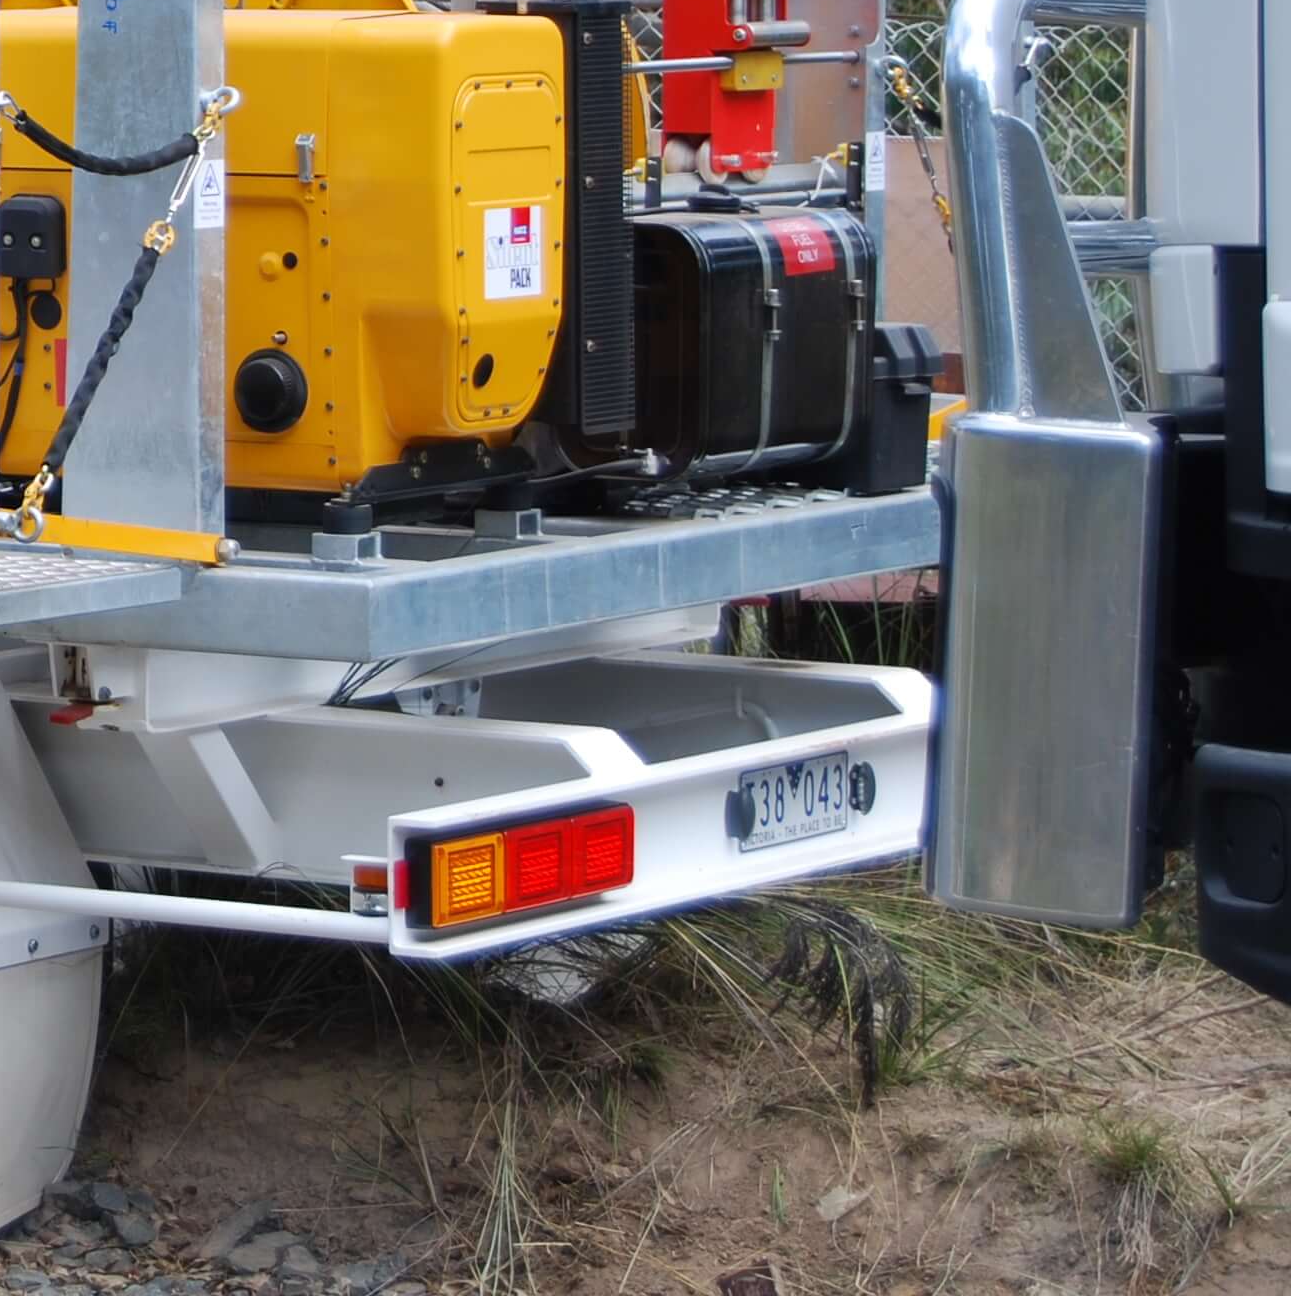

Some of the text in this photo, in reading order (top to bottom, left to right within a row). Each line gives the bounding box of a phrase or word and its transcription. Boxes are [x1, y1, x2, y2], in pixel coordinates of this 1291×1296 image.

[510, 267, 532, 289] PACK
[745, 764, 844, 827] 38 043
